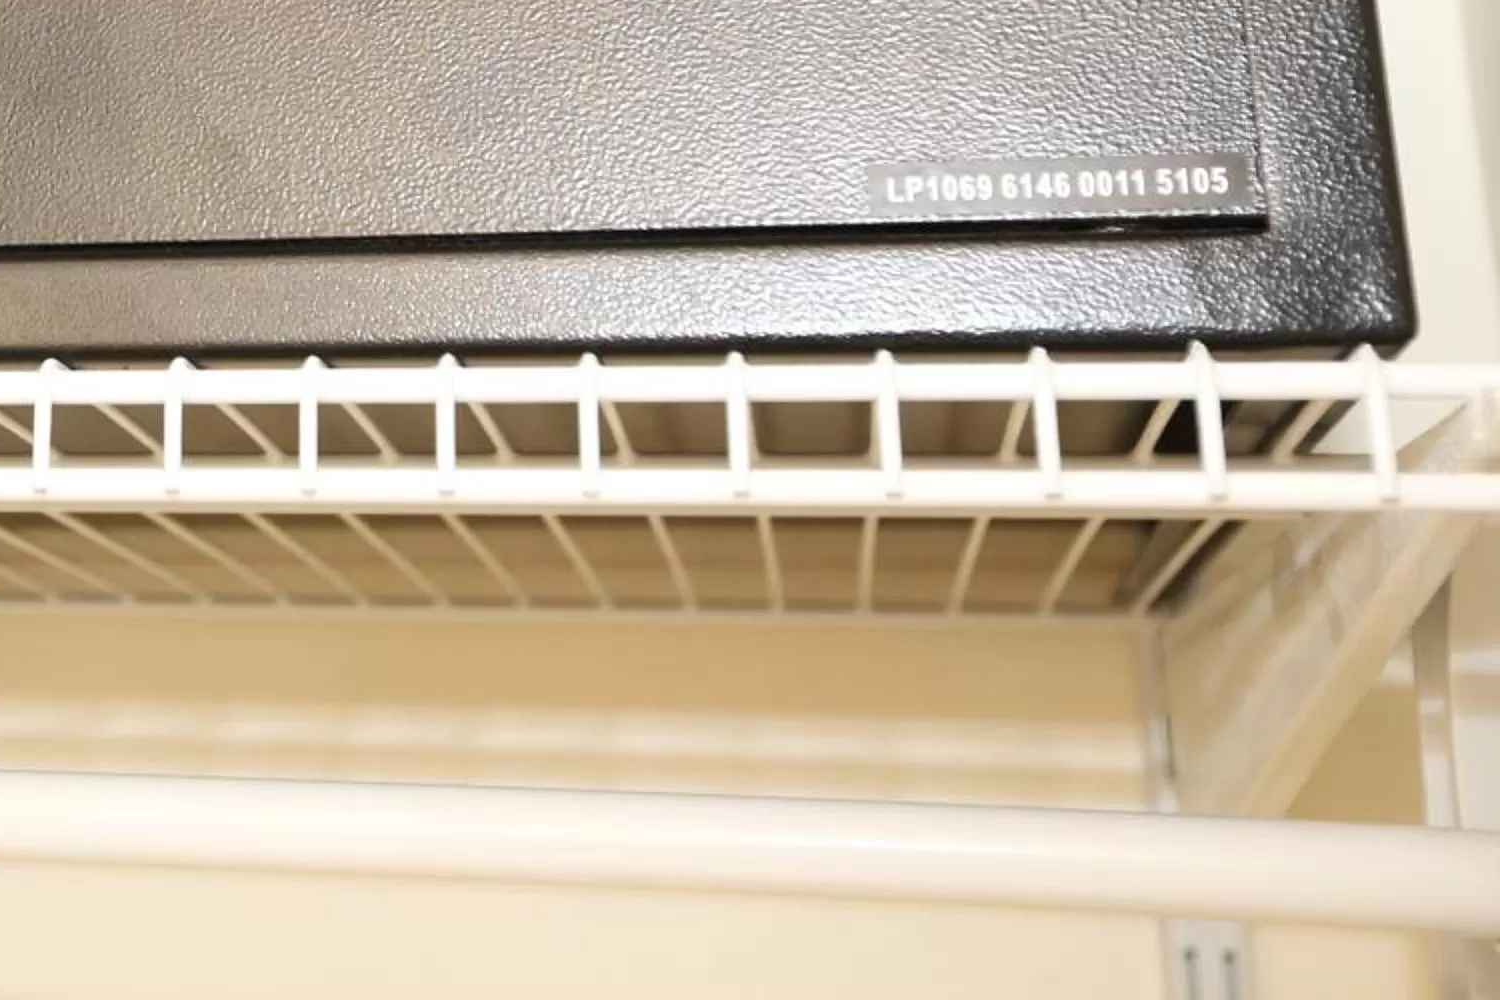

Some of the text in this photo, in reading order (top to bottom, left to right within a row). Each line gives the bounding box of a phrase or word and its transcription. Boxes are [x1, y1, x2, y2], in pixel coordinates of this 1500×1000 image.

[885, 166, 1229, 203] LP1069 6146 0011 5105
